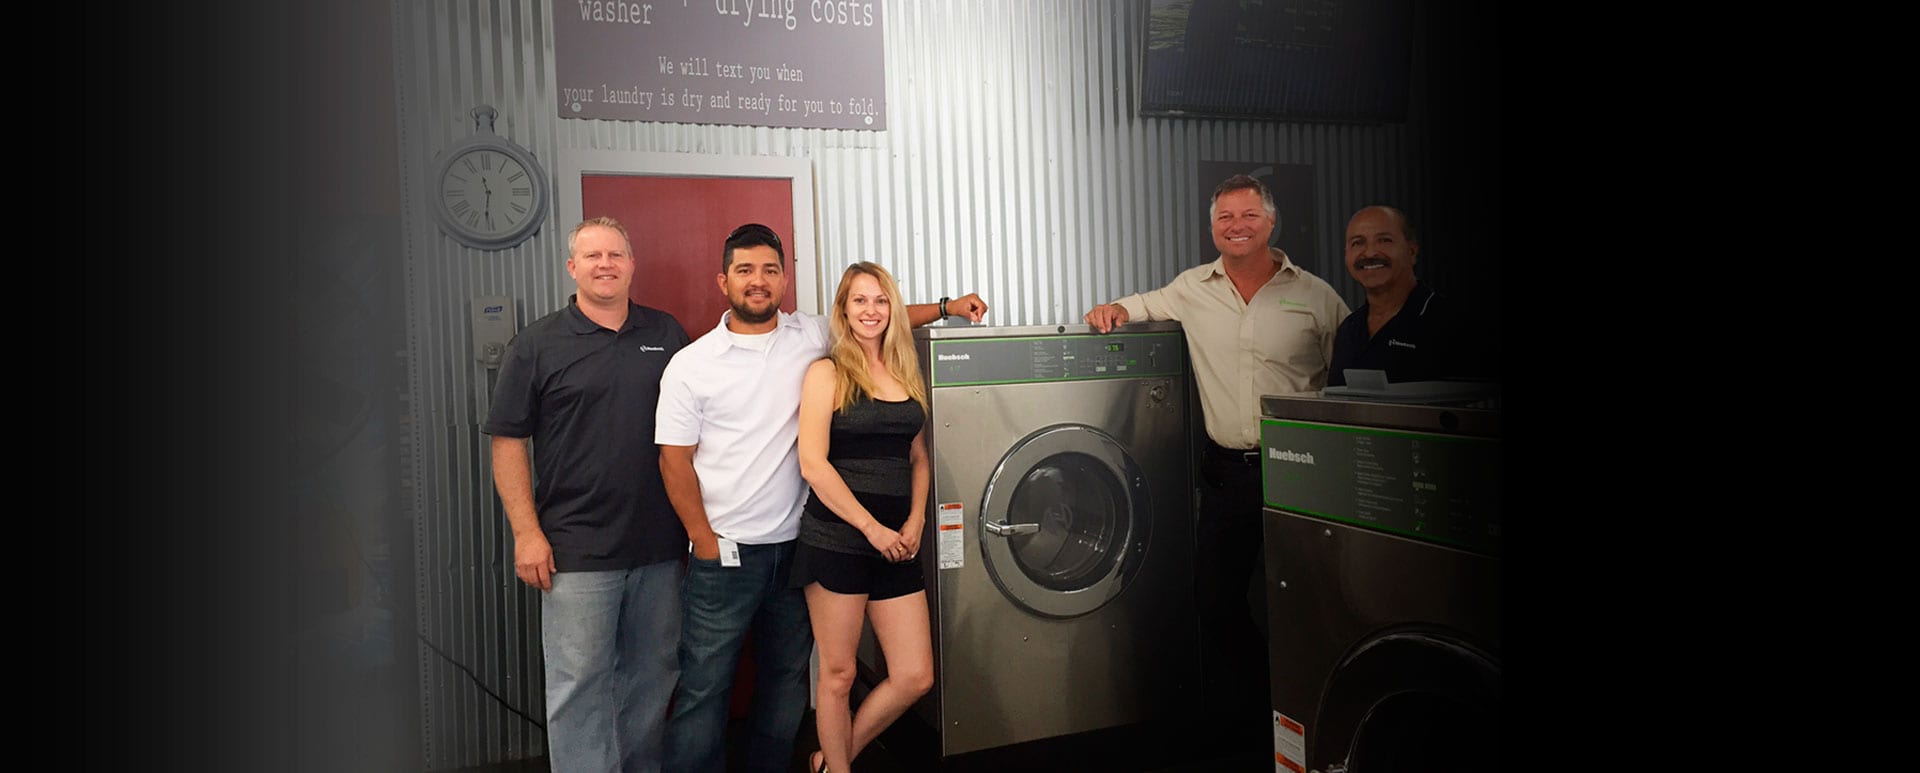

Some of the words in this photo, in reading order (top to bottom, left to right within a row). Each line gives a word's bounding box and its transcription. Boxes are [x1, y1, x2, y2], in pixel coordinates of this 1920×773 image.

[579, 0, 653, 25] washer
[811, 0, 873, 27] costs
[658, 56, 674, 75] We
[680, 57, 709, 77] will
[716, 61, 743, 79] text
[750, 65, 771, 84] you
[776, 64, 803, 82] when
[563, 87, 594, 106] your
[601, 84, 653, 110] laundry
[661, 87, 675, 106] is
[682, 88, 703, 112] dry
[710, 90, 731, 109] and
[738, 92, 771, 115] ready
[778, 94, 798, 112] for
[804, 98, 824, 118] you
[830, 99, 843, 115] to
[849, 97, 879, 117] fold.
[1268, 447, 1314, 465] Huebsch
